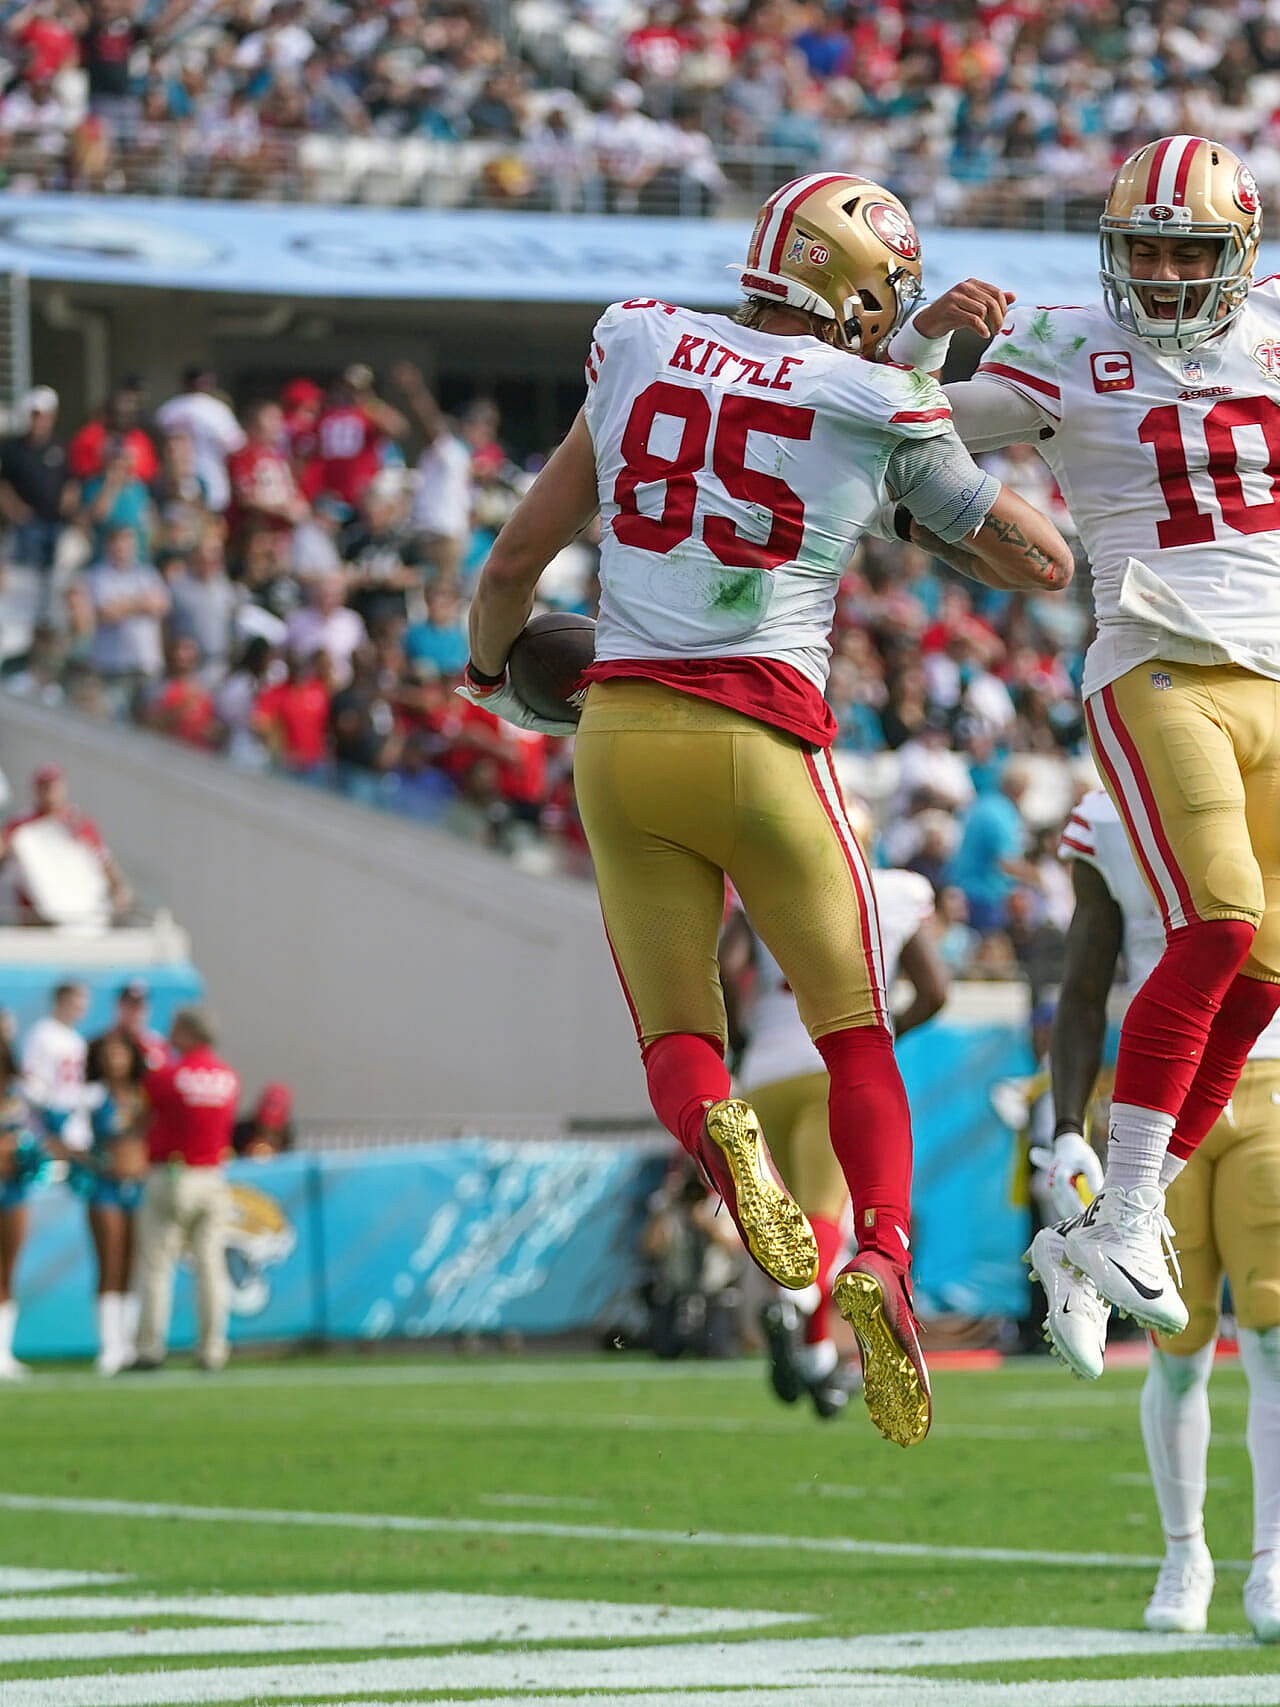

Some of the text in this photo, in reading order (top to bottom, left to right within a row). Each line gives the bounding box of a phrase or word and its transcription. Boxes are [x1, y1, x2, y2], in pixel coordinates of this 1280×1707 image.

[812, 247, 827, 262] 70
[668, 333, 805, 391] KITTLE
[1095, 353, 1131, 381] C
[1177, 386, 1233, 401] 49ERS
[611, 380, 816, 570] 85
